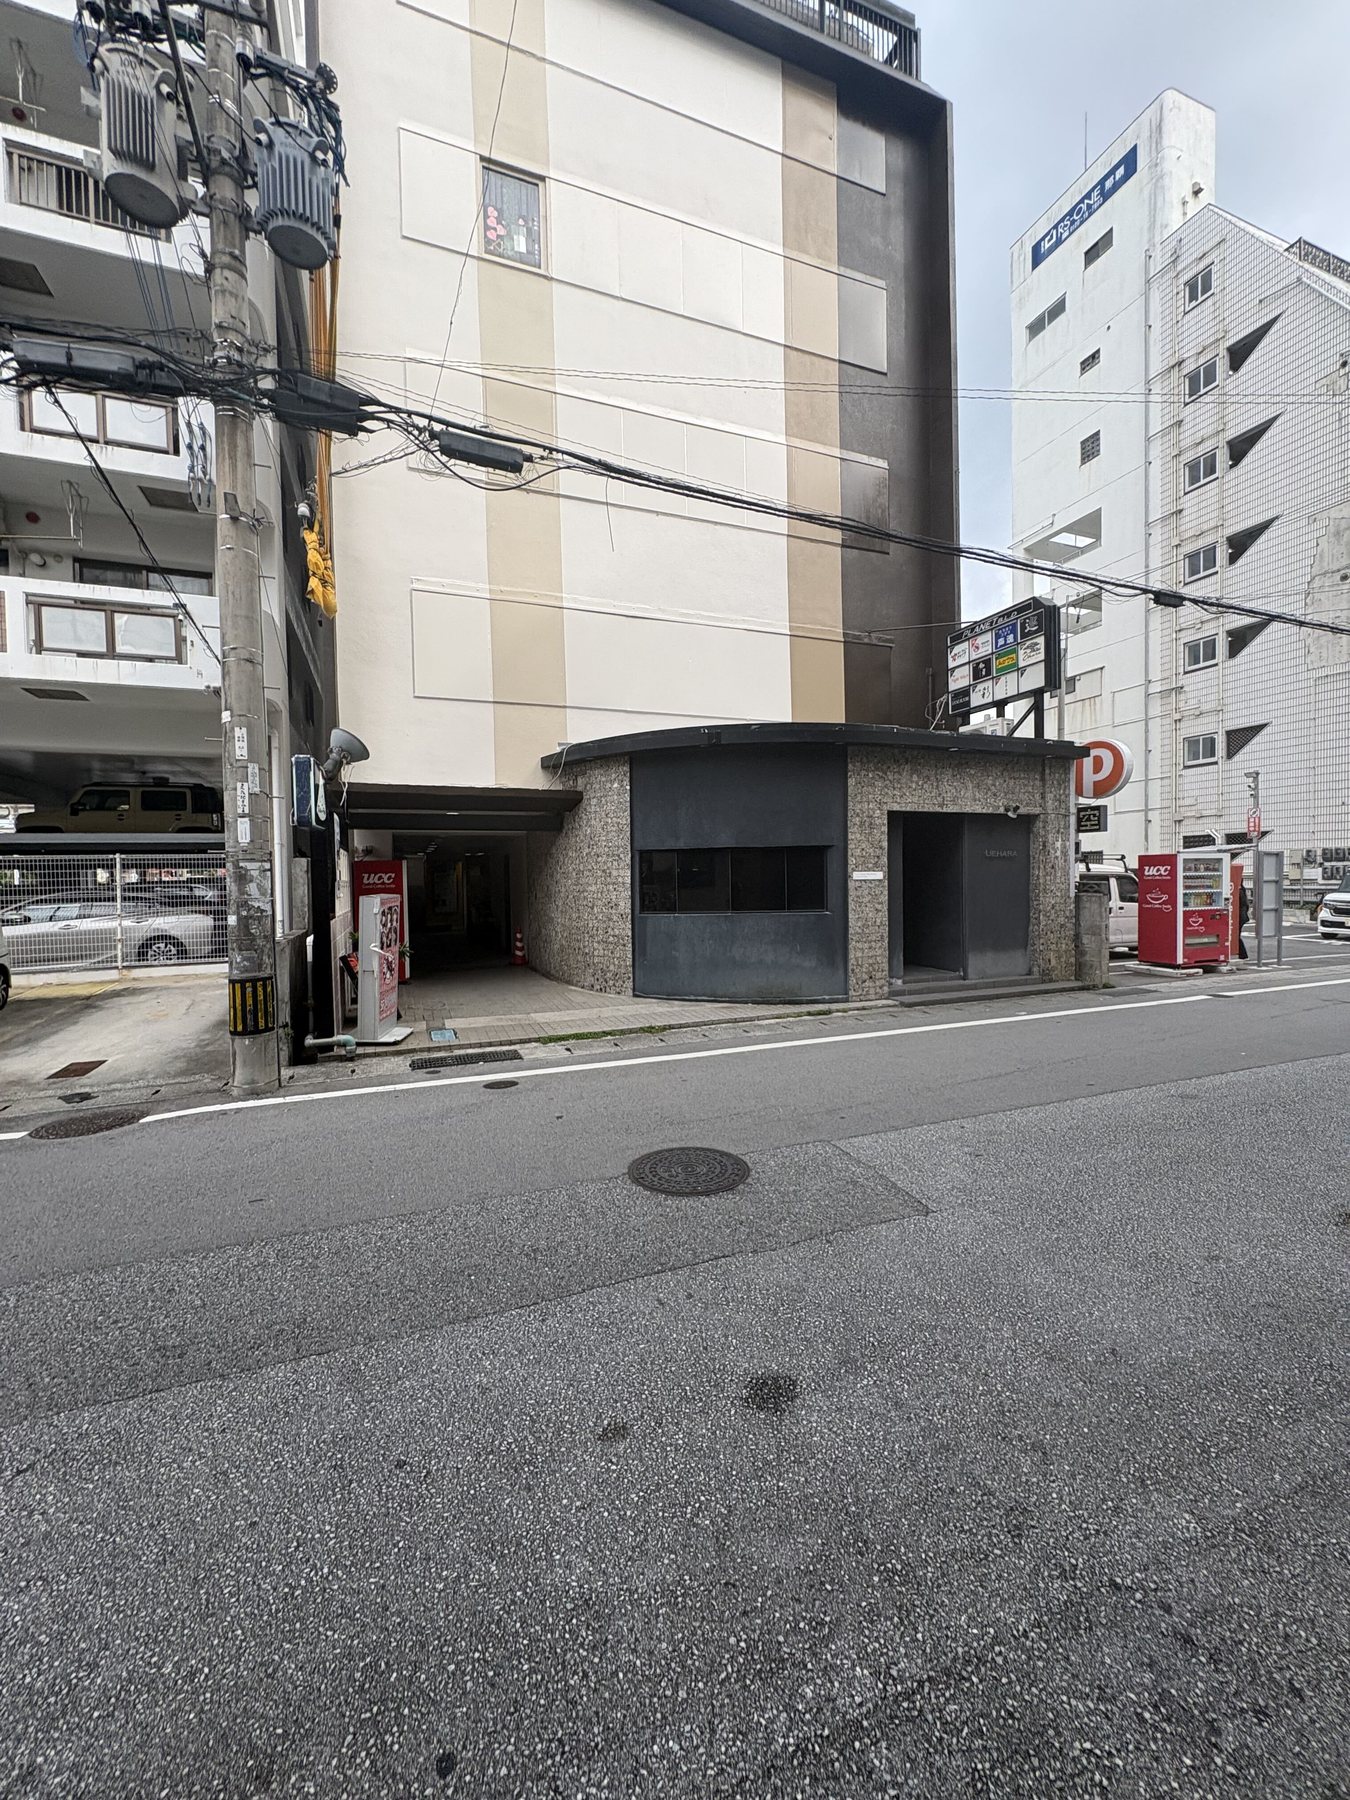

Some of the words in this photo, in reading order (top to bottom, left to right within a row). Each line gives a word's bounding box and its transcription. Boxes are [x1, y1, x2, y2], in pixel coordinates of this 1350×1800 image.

[1057, 185, 1101, 239] RS-ONE
[962, 616, 998, 639] PLANET
[1082, 748, 1115, 797] P
[1079, 809, 1100, 831] 空
